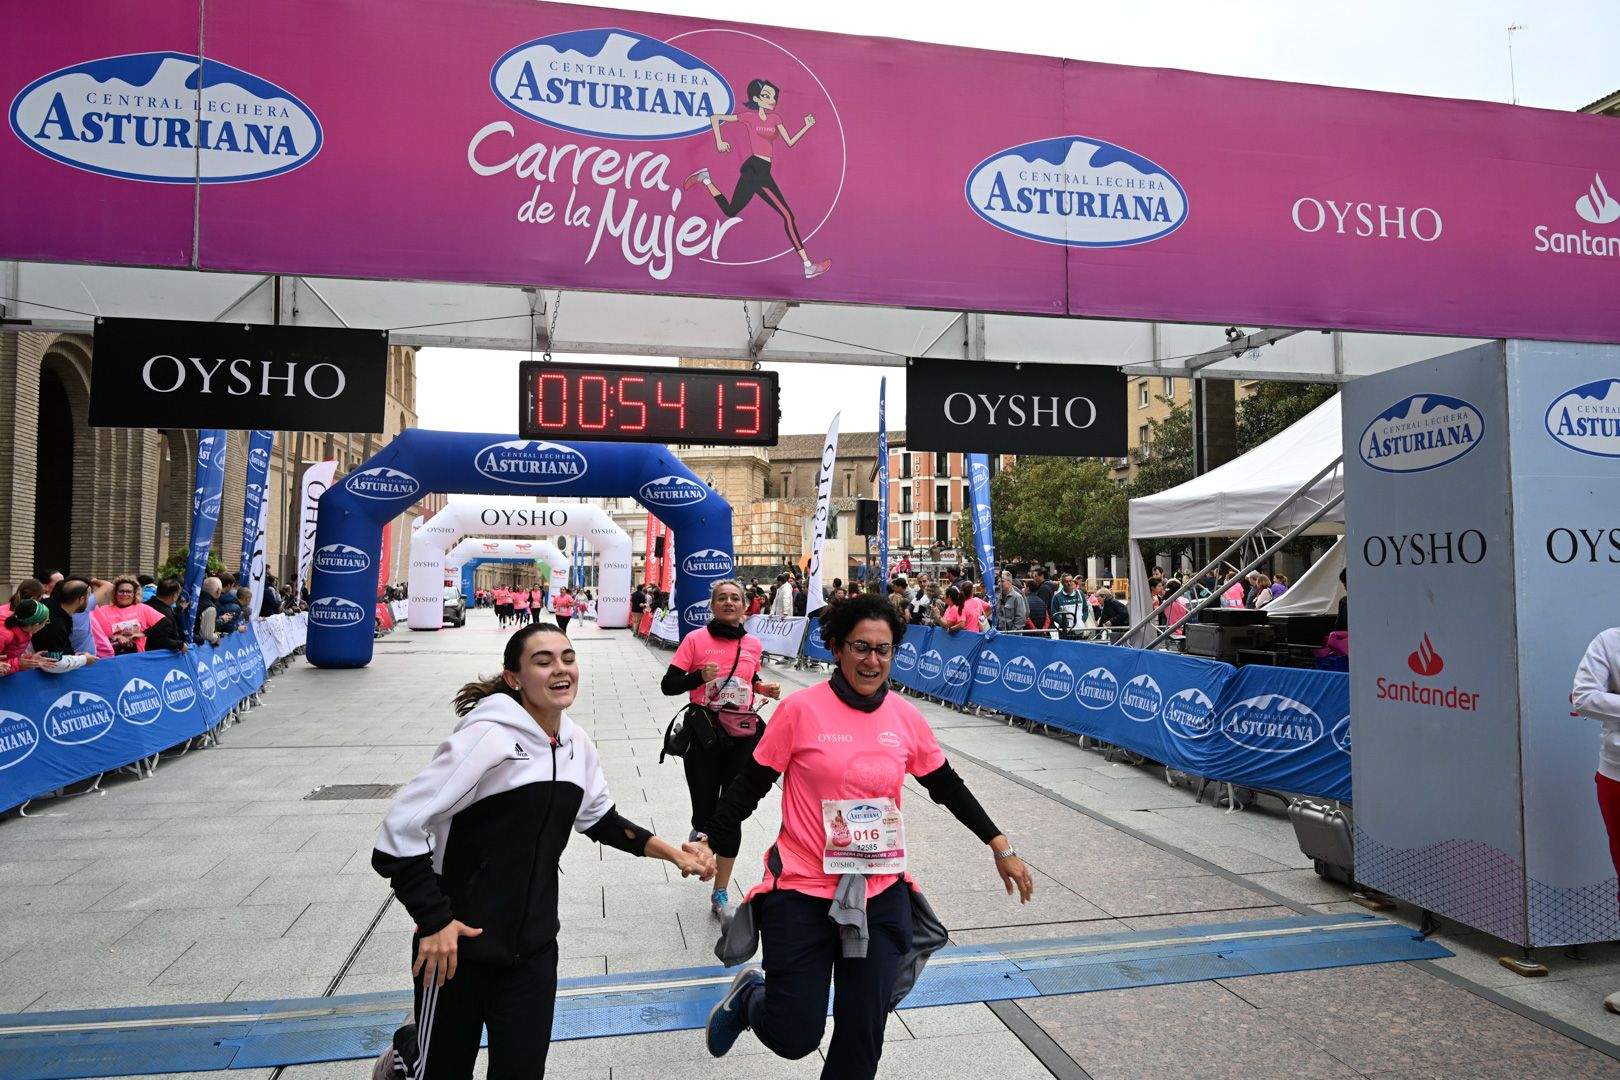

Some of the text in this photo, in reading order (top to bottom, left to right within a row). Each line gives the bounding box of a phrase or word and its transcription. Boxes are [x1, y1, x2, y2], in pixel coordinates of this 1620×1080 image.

[549, 61, 709, 86] CENTRAL LECHERA
[510, 60, 714, 118] ASTURIANA
[86, 92, 290, 118] CENTRAL LECHERA
[34, 92, 299, 157] ASTURIANA
[467, 121, 671, 192] Carrera
[1019, 170, 1165, 191] CENTRAL LECHERA
[984, 171, 1172, 223] ASTURIANA
[1292, 197, 1443, 242] OYSHO
[517, 185, 743, 281] de la Mujer
[142, 355, 346, 400] OYSHO
[538, 374, 761, 434] 00:54 13
[944, 392, 1097, 429] OYSHO
[1383, 410, 1469, 435] CENTRAL LECHERA
[1367, 422, 1474, 460] ASTURIANA
[484, 452, 579, 475] ASTURIANA
[540, 452, 576, 460] LECHERA
[350, 478, 414, 493] ASTURIANA
[645, 487, 702, 499] ASTURIANA
[481, 508, 568, 527] OYSHO
[1363, 529, 1487, 567] OYSHO
[316, 554, 366, 569] ASTURIANA
[686, 558, 731, 571] ASTURIANA
[310, 606, 360, 621] ASTURIANA
[756, 619, 794, 637] OYSHO
[1039, 673, 1070, 692] ASTURIANA
[1077, 681, 1114, 701] ASTURIANA
[1376, 677, 1480, 711] Santander
[123, 697, 161, 717] ASTURIANA
[52, 709, 111, 737] ASTURIANA
[1225, 712, 1314, 741] ASTURIANA
[818, 734, 852, 743] OYSHO
[853, 829, 880, 841] 016
